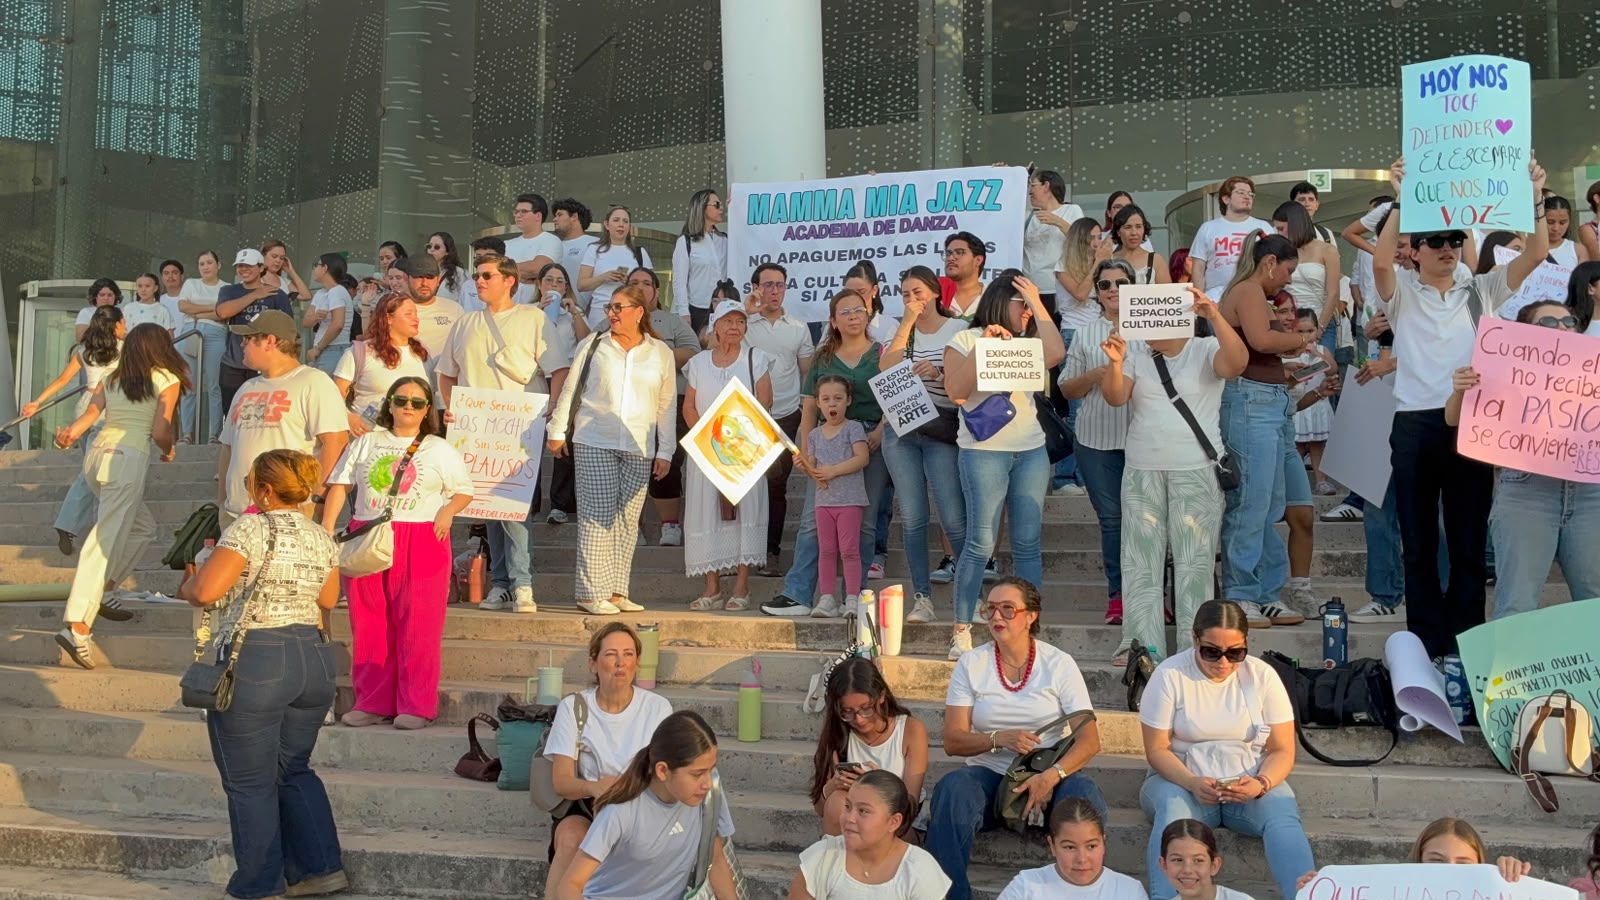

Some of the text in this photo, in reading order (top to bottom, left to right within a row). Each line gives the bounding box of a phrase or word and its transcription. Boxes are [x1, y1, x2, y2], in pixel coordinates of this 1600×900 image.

[1420, 62, 1508, 98] HOY NOS
[1409, 119, 1494, 150] DEFENDER
[1314, 174, 1325, 187] 3
[1414, 177, 1509, 204] QUE NOS DIO
[747, 179, 1003, 225] MAMMA MIA JAZZ
[1440, 204, 1495, 228] VOZ
[783, 214, 958, 241] ACADEMIA DE DANZA
[749, 254, 772, 267] NO
[777, 246, 887, 265] APAGUEMOS
[893, 243, 928, 257] LAS
[804, 272, 887, 288] CULTA
[801, 290, 818, 302] SI
[1130, 296, 1182, 306] EXIGIMOS
[1130, 308, 1183, 317] ESPACIOS
[1122, 319, 1191, 329] CULTURALES
[986, 350, 1033, 358] EXIGIMOS
[1480, 326, 1571, 366] Cuando
[874, 365, 910, 388] NO ESTOY
[897, 372, 914, 384] POR
[979, 371, 1041, 380] CULTURALES
[1511, 367, 1536, 386] no
[887, 399, 906, 413] ESTOY
[896, 400, 921, 416] POR EL
[1472, 389, 1505, 421] la
[453, 413, 479, 433] LOS
[898, 403, 930, 428] ARTE
[1468, 425, 1493, 447] se
[463, 452, 535, 479] PLAUSOS
[1550, 652, 1594, 669] TEATRO
